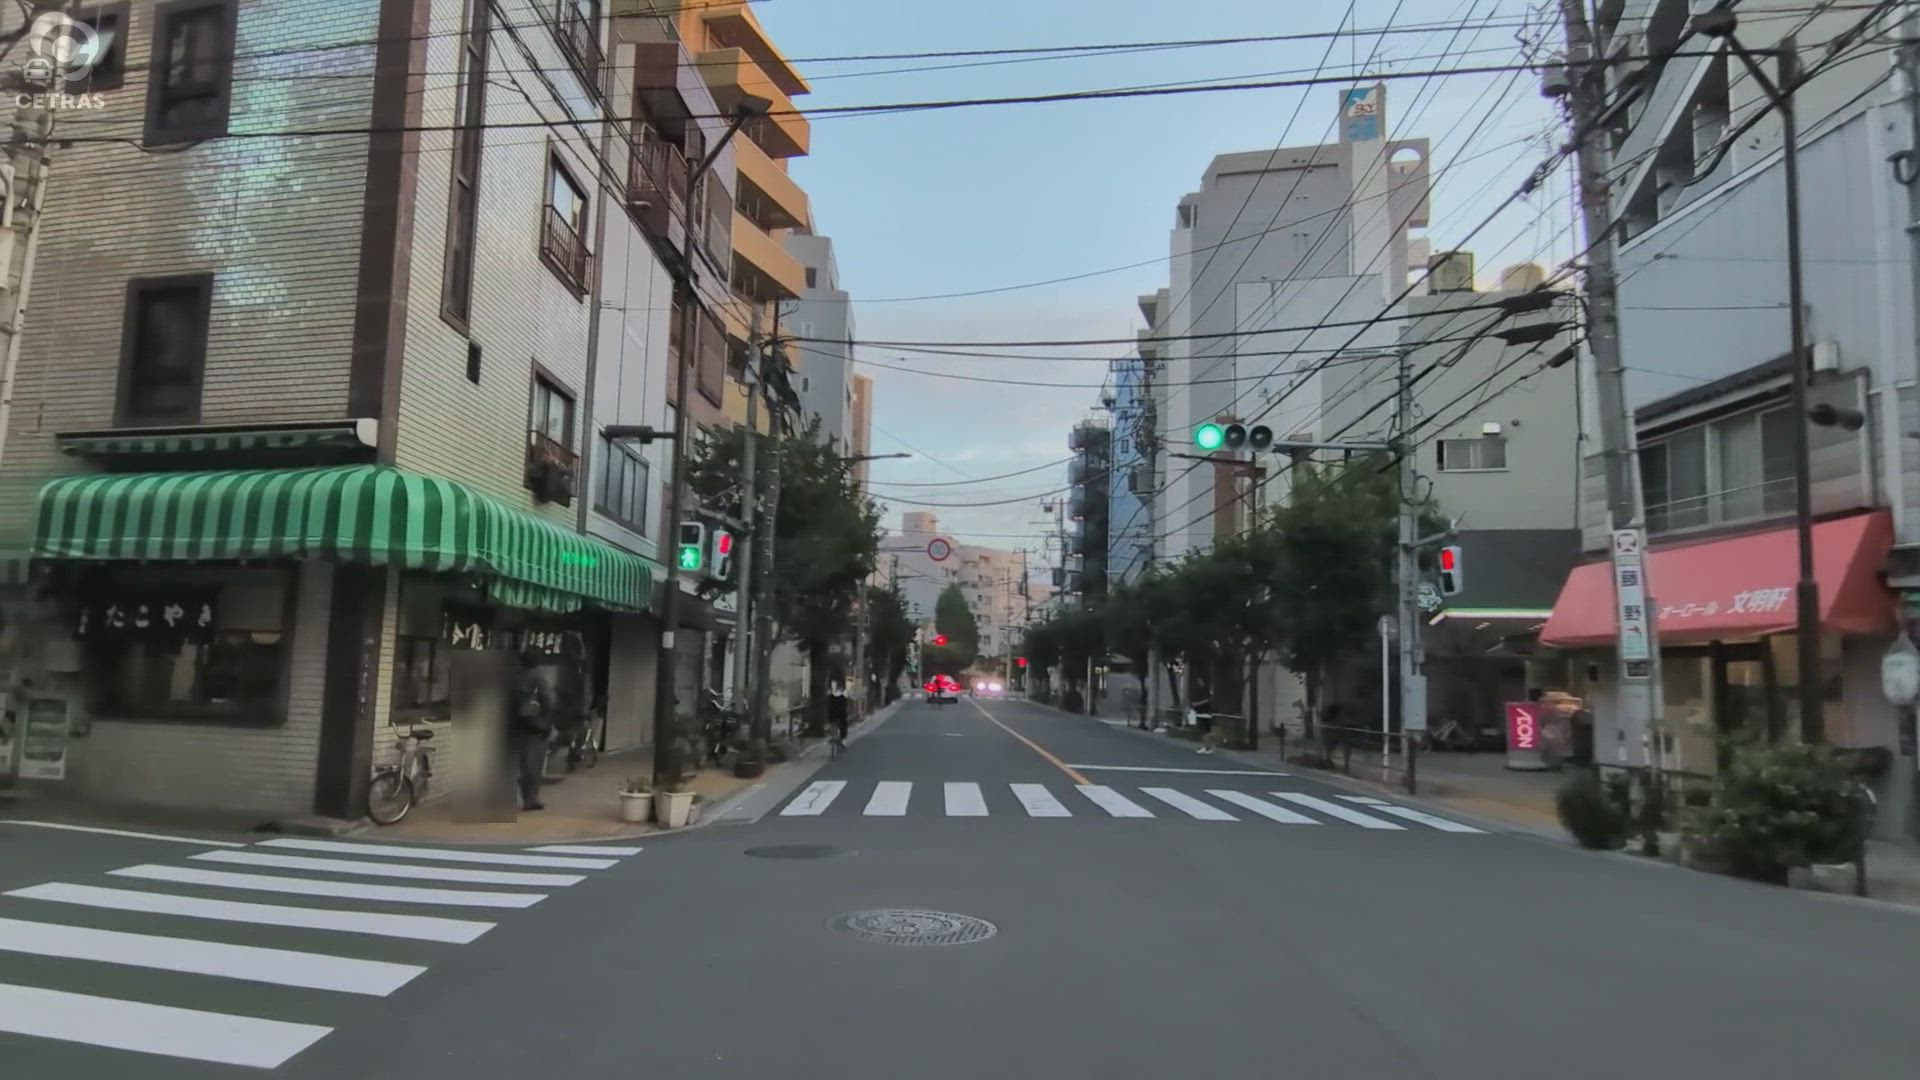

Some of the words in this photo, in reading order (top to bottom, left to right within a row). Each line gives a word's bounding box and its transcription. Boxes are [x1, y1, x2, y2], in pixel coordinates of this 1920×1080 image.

[1726, 587, 1791, 613] 文明軒
[106, 604, 212, 628] たこやき
[1516, 707, 1534, 748] AEON
